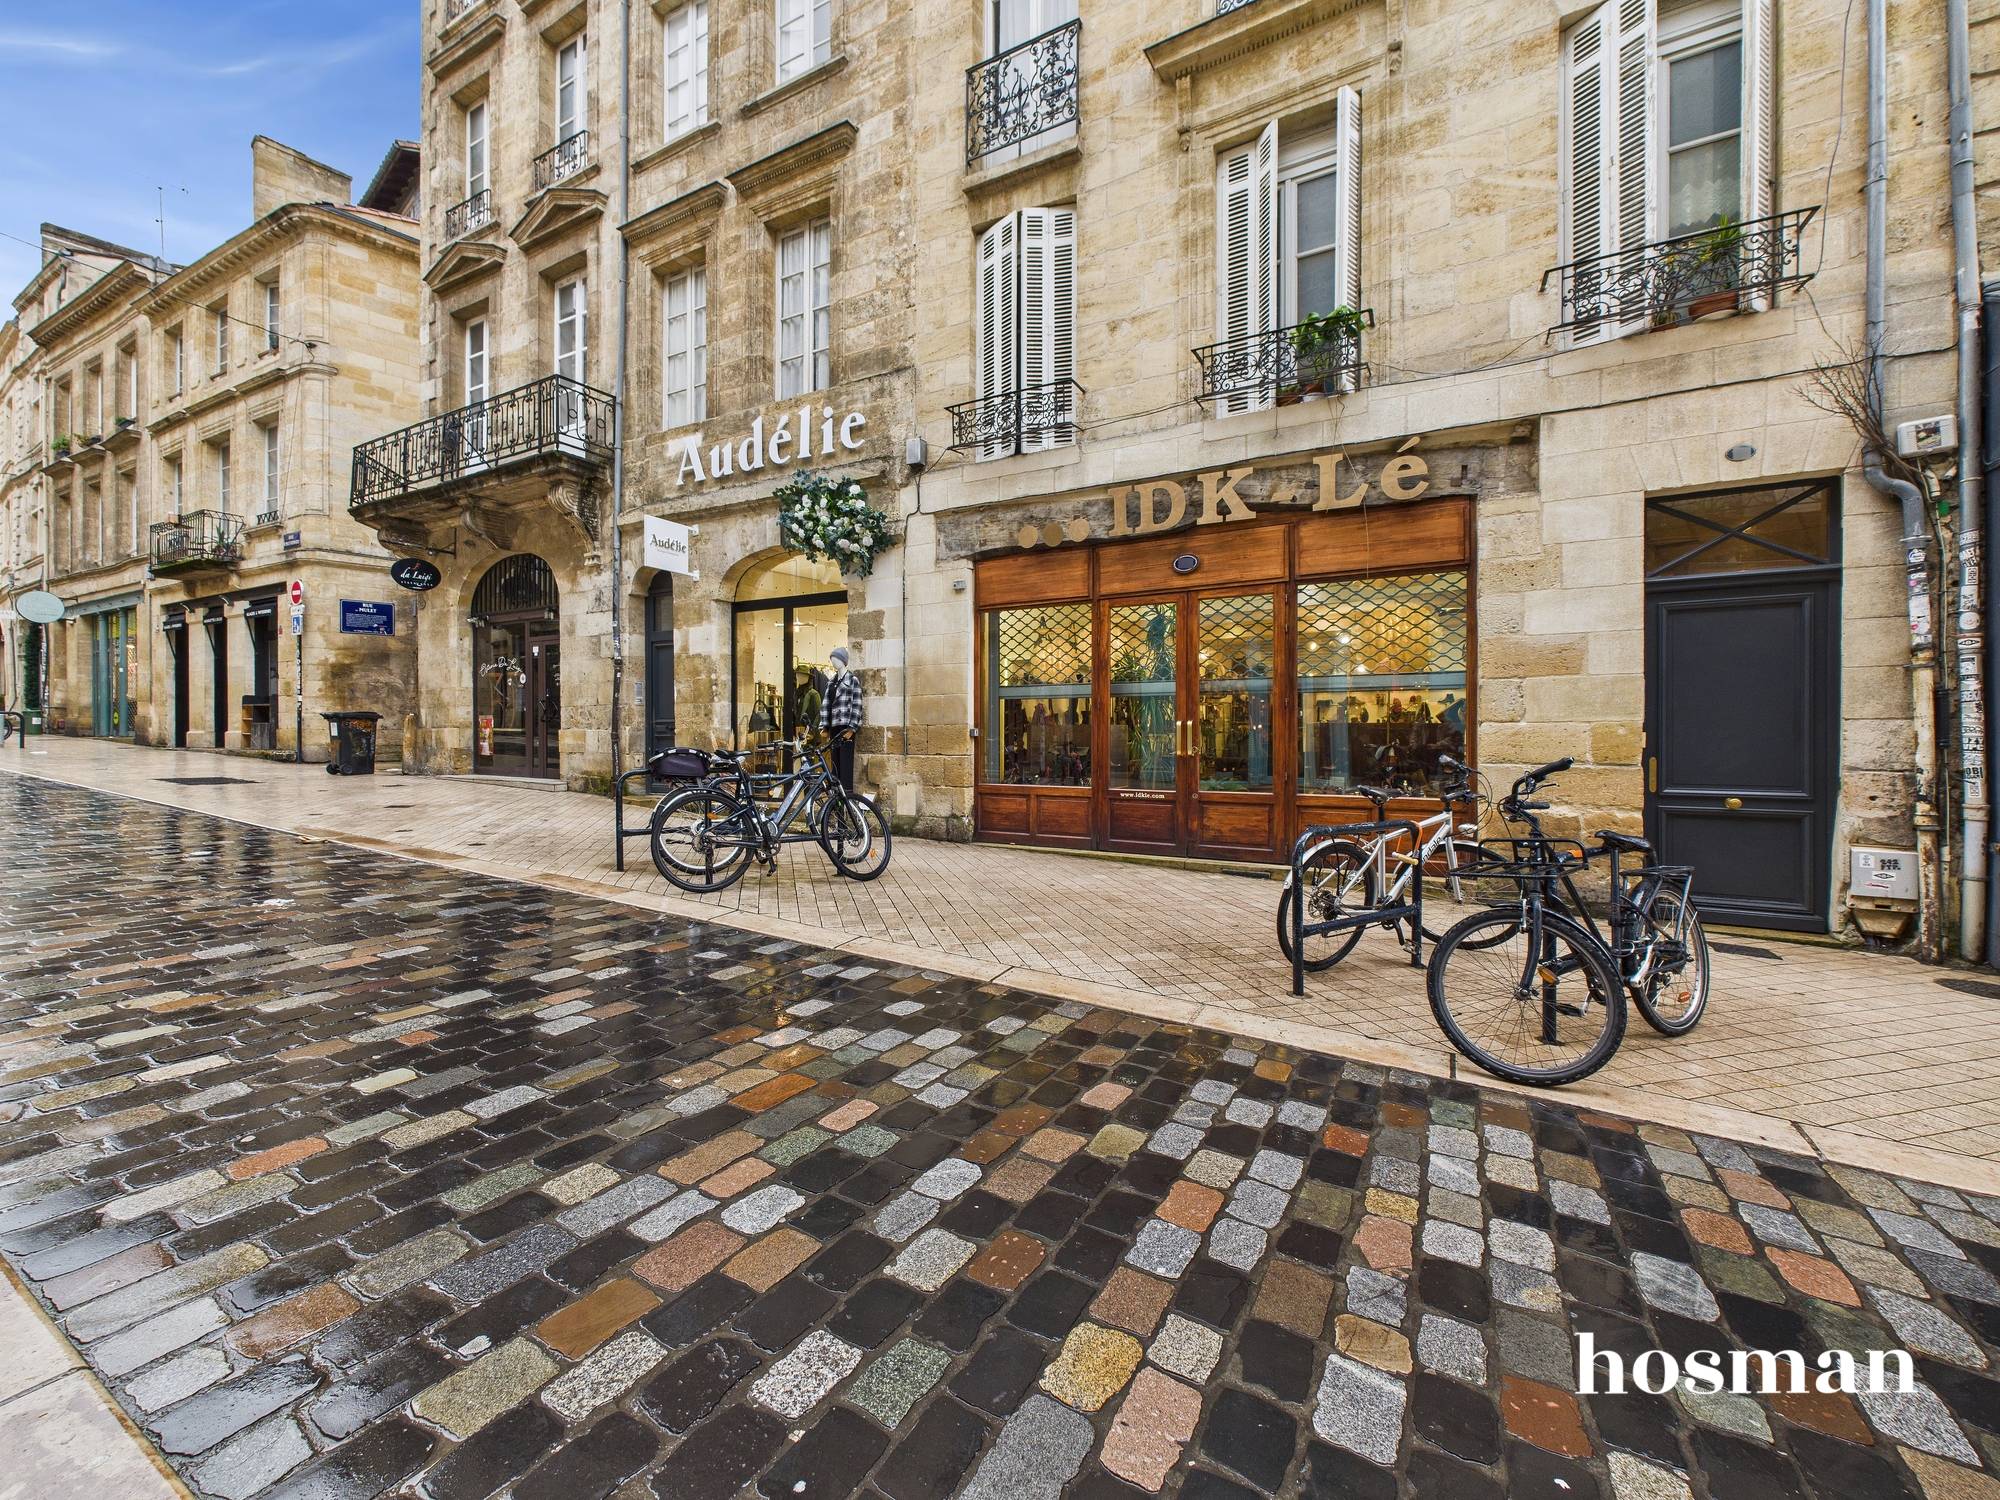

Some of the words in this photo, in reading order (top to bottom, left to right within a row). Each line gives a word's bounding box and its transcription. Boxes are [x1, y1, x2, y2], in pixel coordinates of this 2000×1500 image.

[676, 405, 866, 486] Audélie
[650, 533, 687, 554] Audélie
[1120, 791, 1165, 799] www.idkle.com
